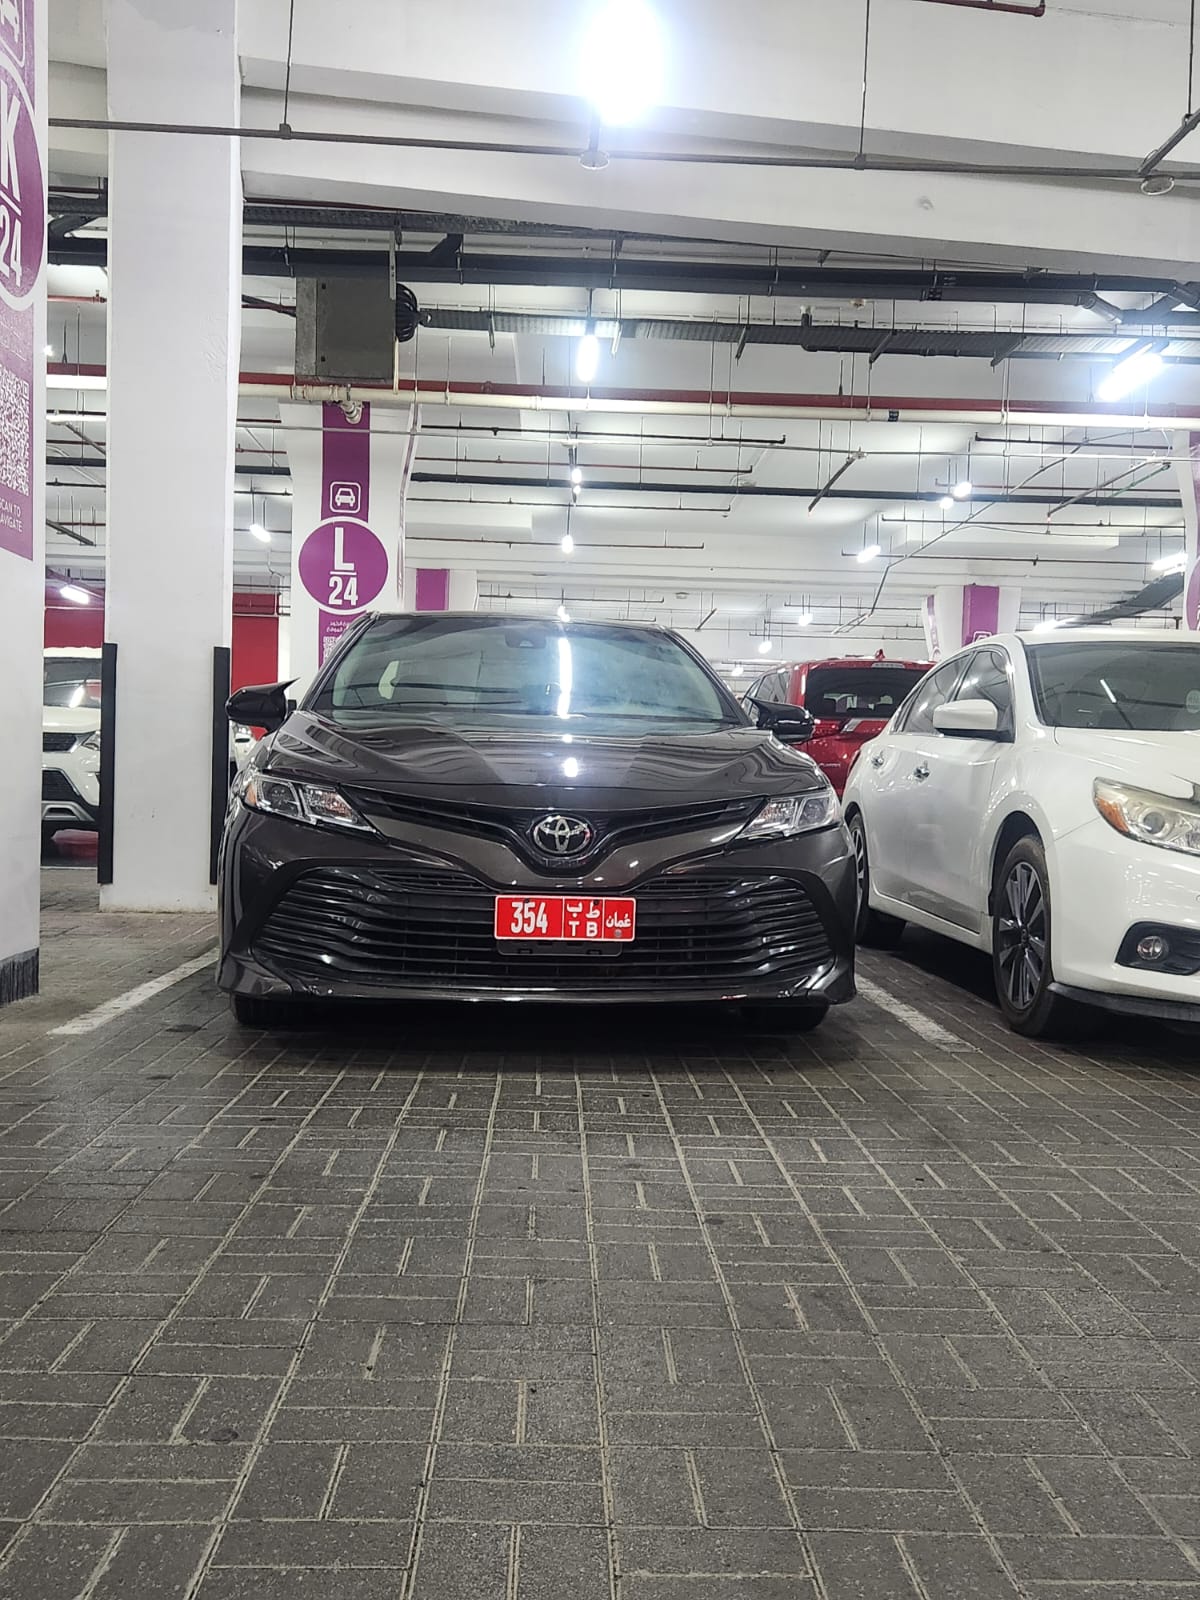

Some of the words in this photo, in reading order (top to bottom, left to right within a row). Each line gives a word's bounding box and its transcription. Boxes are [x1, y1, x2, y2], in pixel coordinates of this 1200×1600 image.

[0, 80, 21, 202] K
[0, 205, 22, 288] 24
[0, 513, 23, 533] AVIGATE
[334, 527, 355, 571] L
[328, 576, 359, 606] 24
[510, 901, 548, 934] 354
[568, 920, 580, 937] T
[586, 921, 598, 937] B
